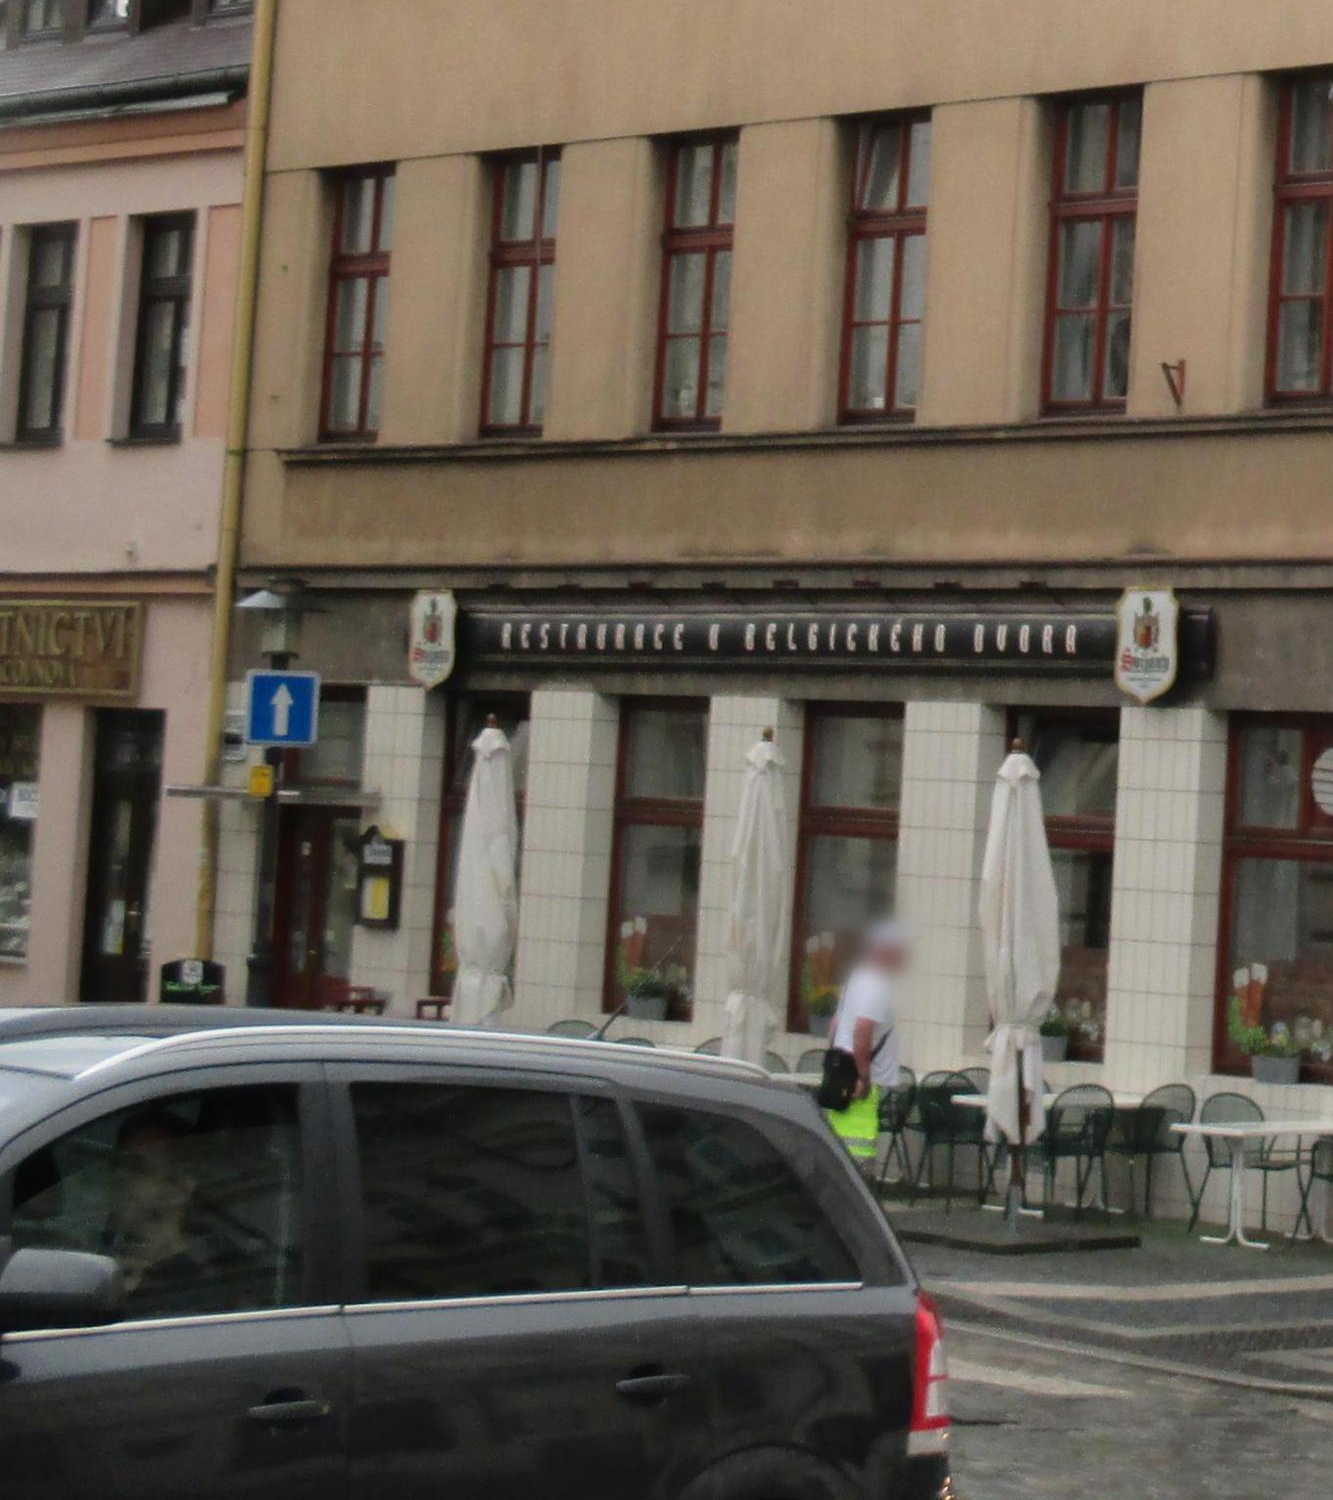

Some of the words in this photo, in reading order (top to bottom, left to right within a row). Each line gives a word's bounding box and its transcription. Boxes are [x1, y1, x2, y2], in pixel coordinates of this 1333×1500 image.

[501, 621, 684, 651] RESTAURACE
[708, 622, 721, 652] U
[744, 617, 947, 653] BELGICKÉHO
